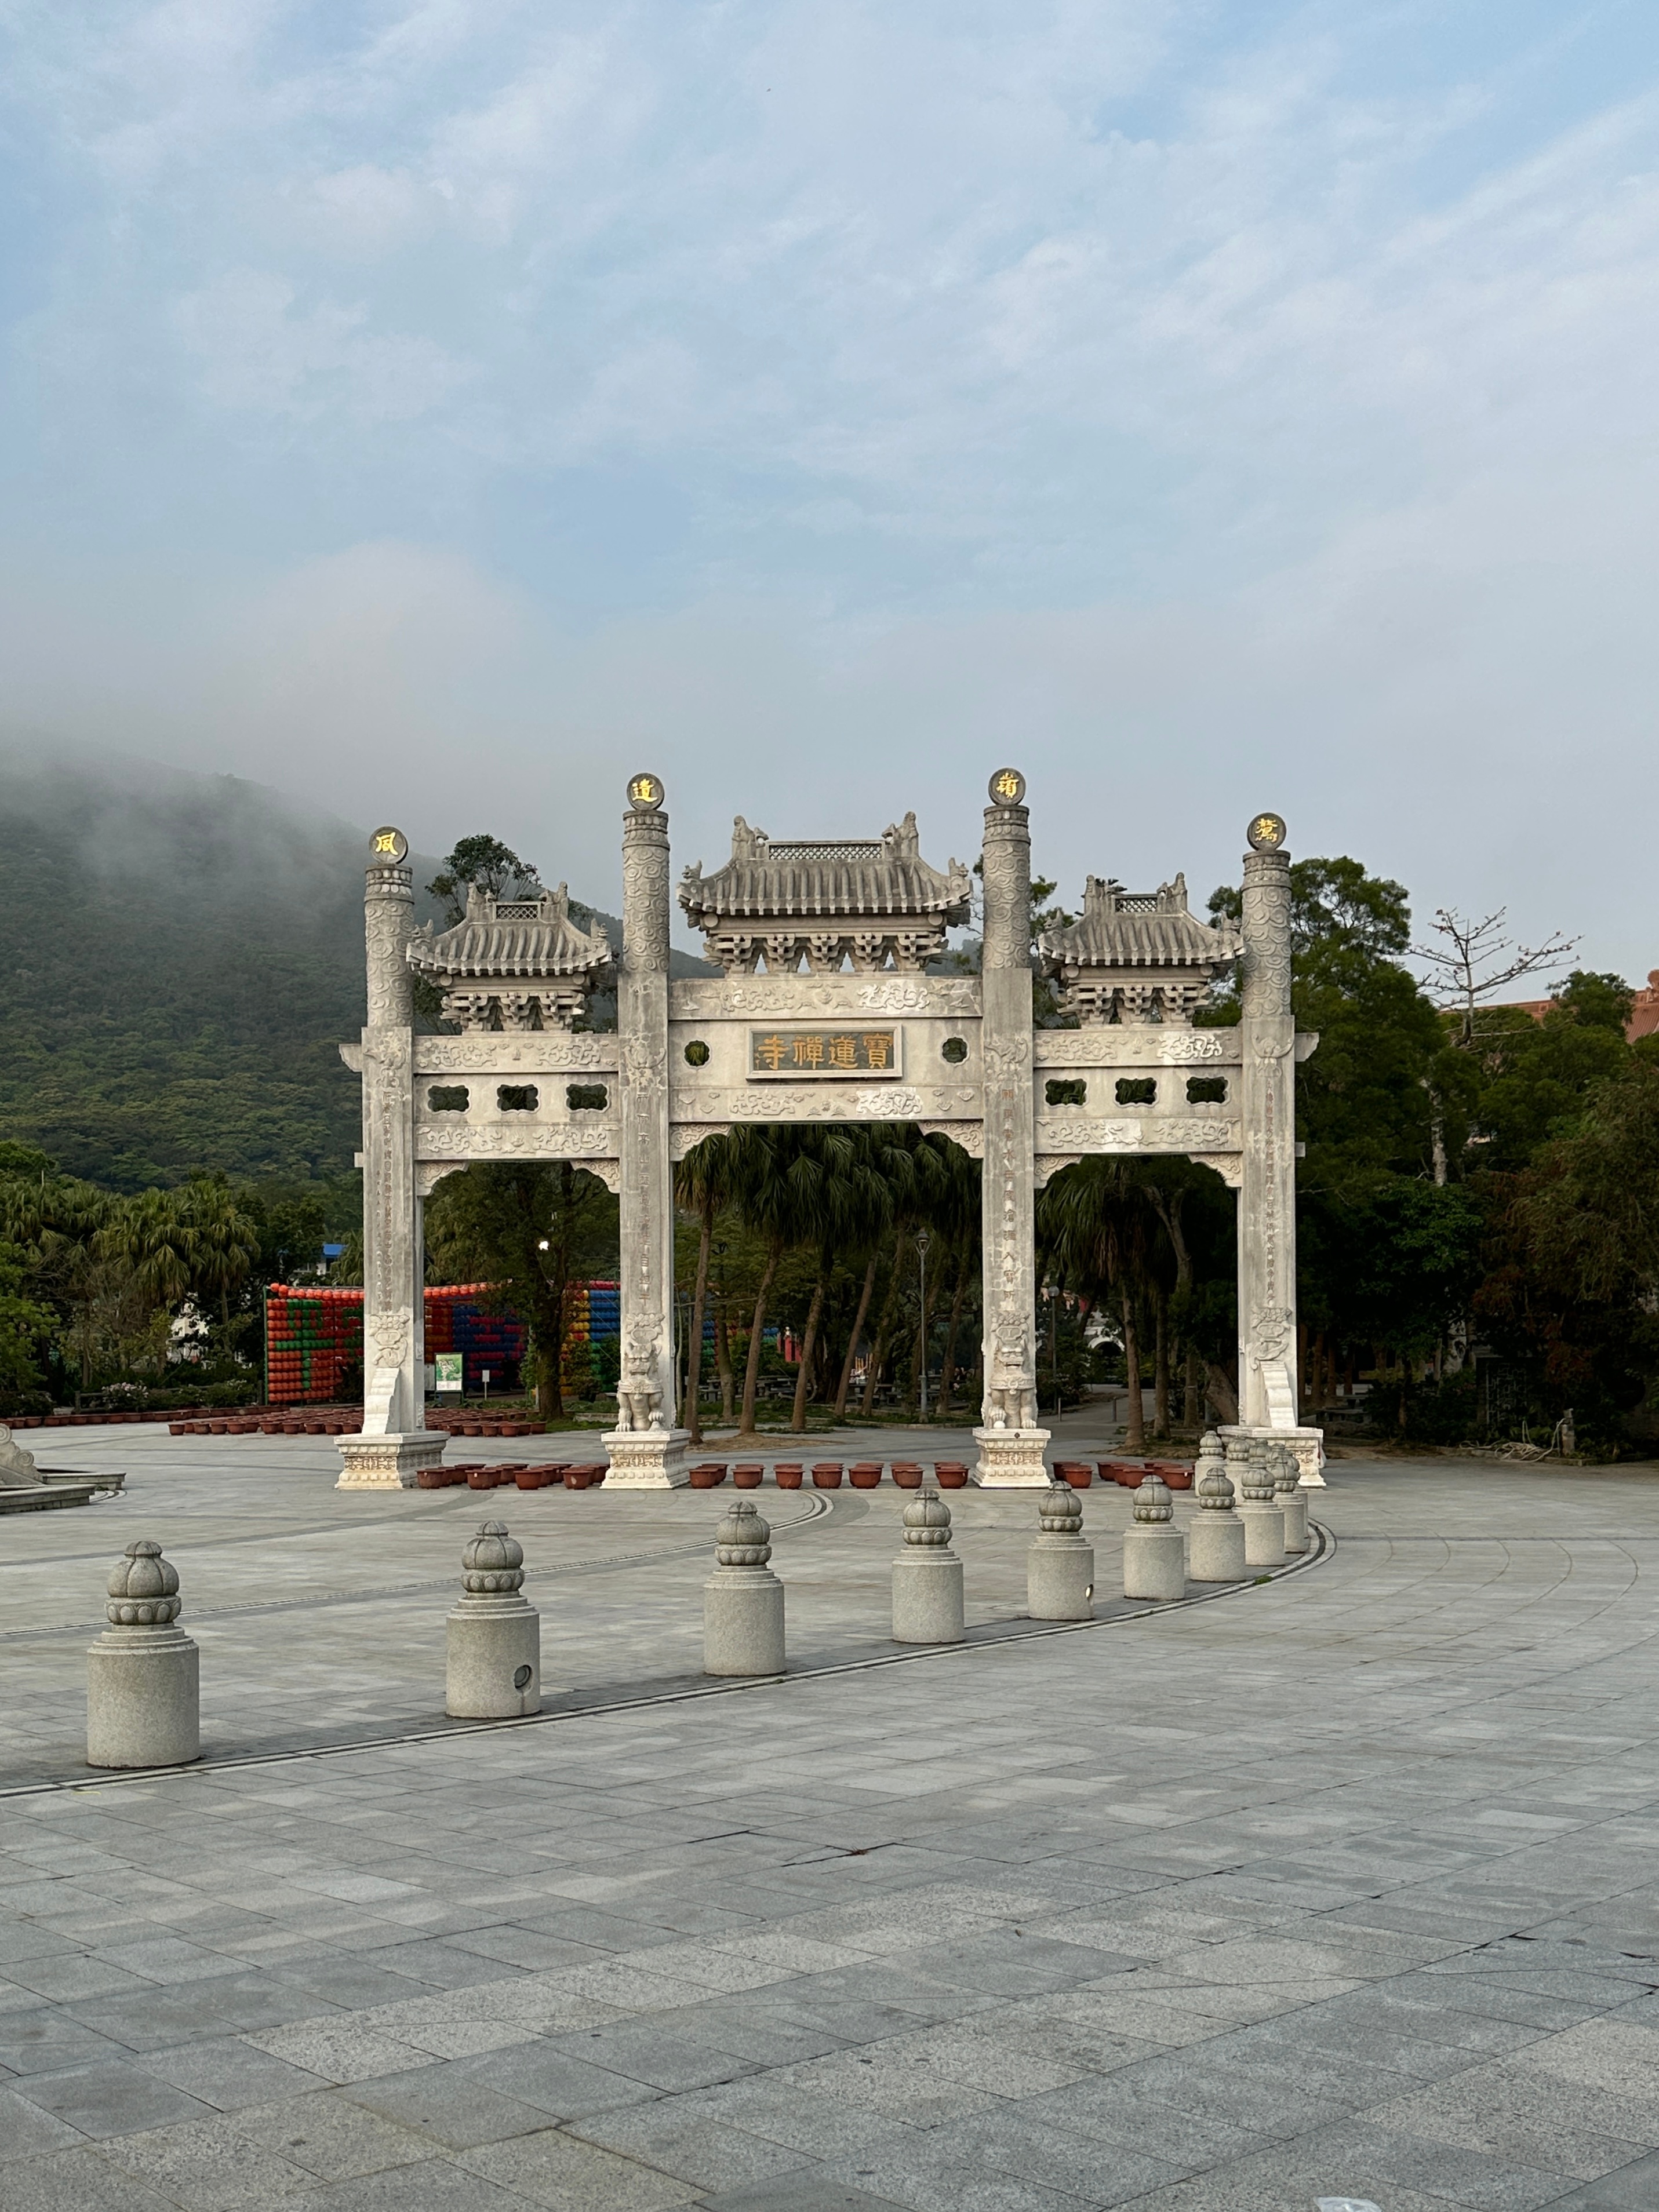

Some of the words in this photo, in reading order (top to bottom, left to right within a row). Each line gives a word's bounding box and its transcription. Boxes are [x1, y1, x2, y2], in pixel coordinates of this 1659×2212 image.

[375, 832, 399, 855] 風
[758, 1033, 894, 1070] 寶蓮禪寺
